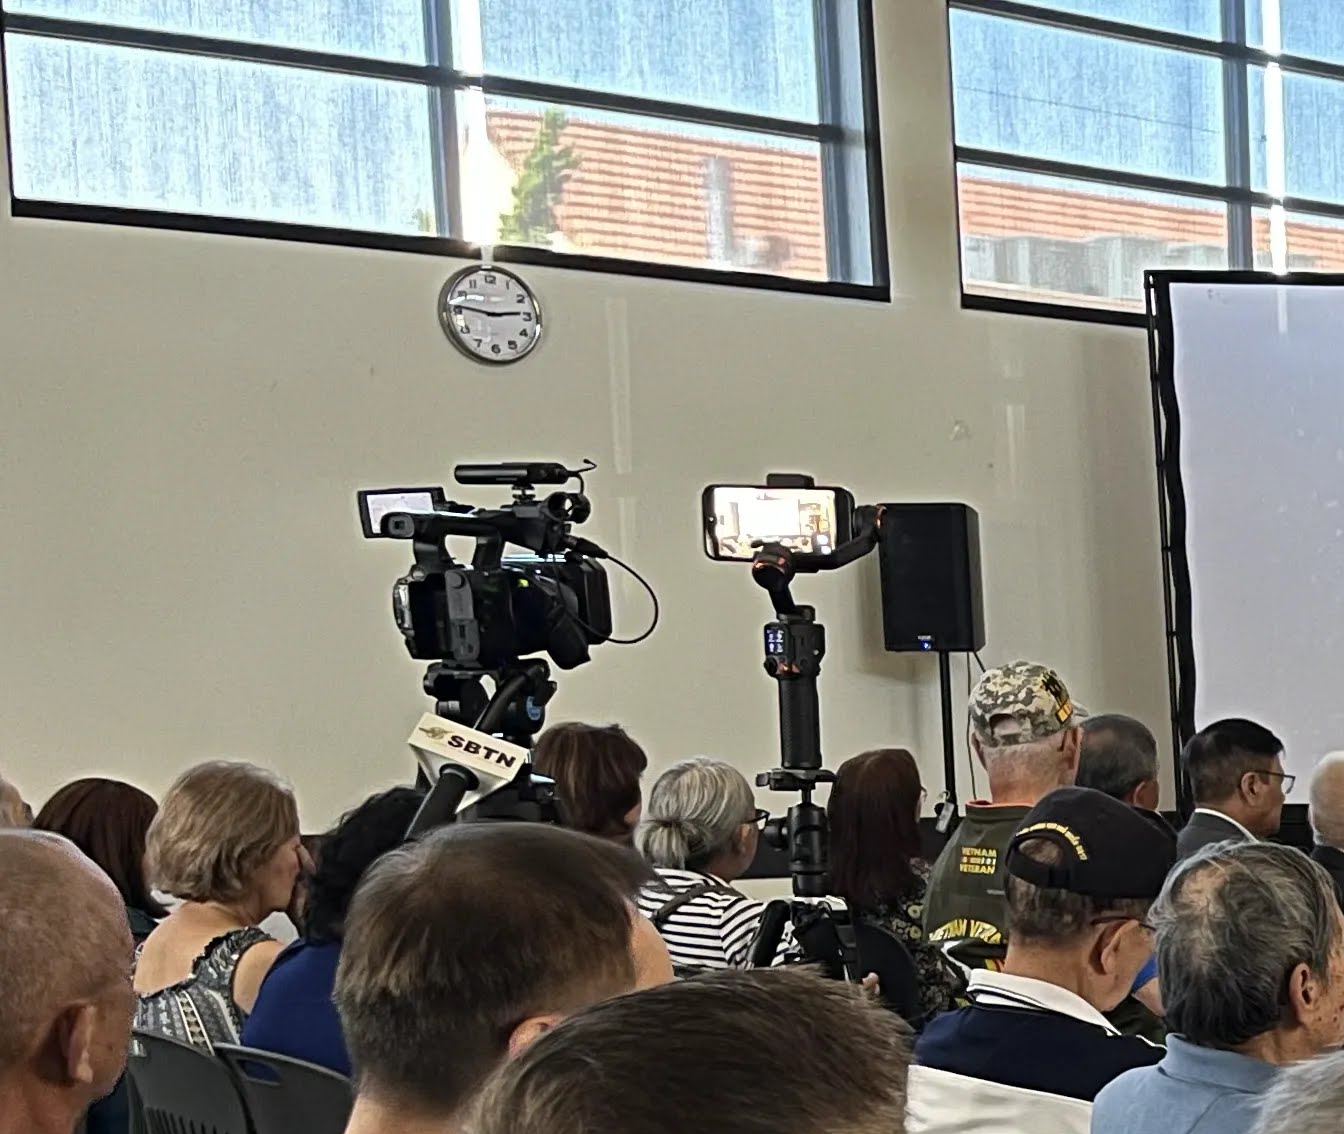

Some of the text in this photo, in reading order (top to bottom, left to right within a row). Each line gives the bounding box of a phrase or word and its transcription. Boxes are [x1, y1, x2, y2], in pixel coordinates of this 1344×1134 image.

[516, 294, 526, 304] 2
[522, 312, 533, 322] 3
[519, 328, 529, 338] 4
[491, 344, 501, 354] 6
[447, 735, 516, 767] SBTN
